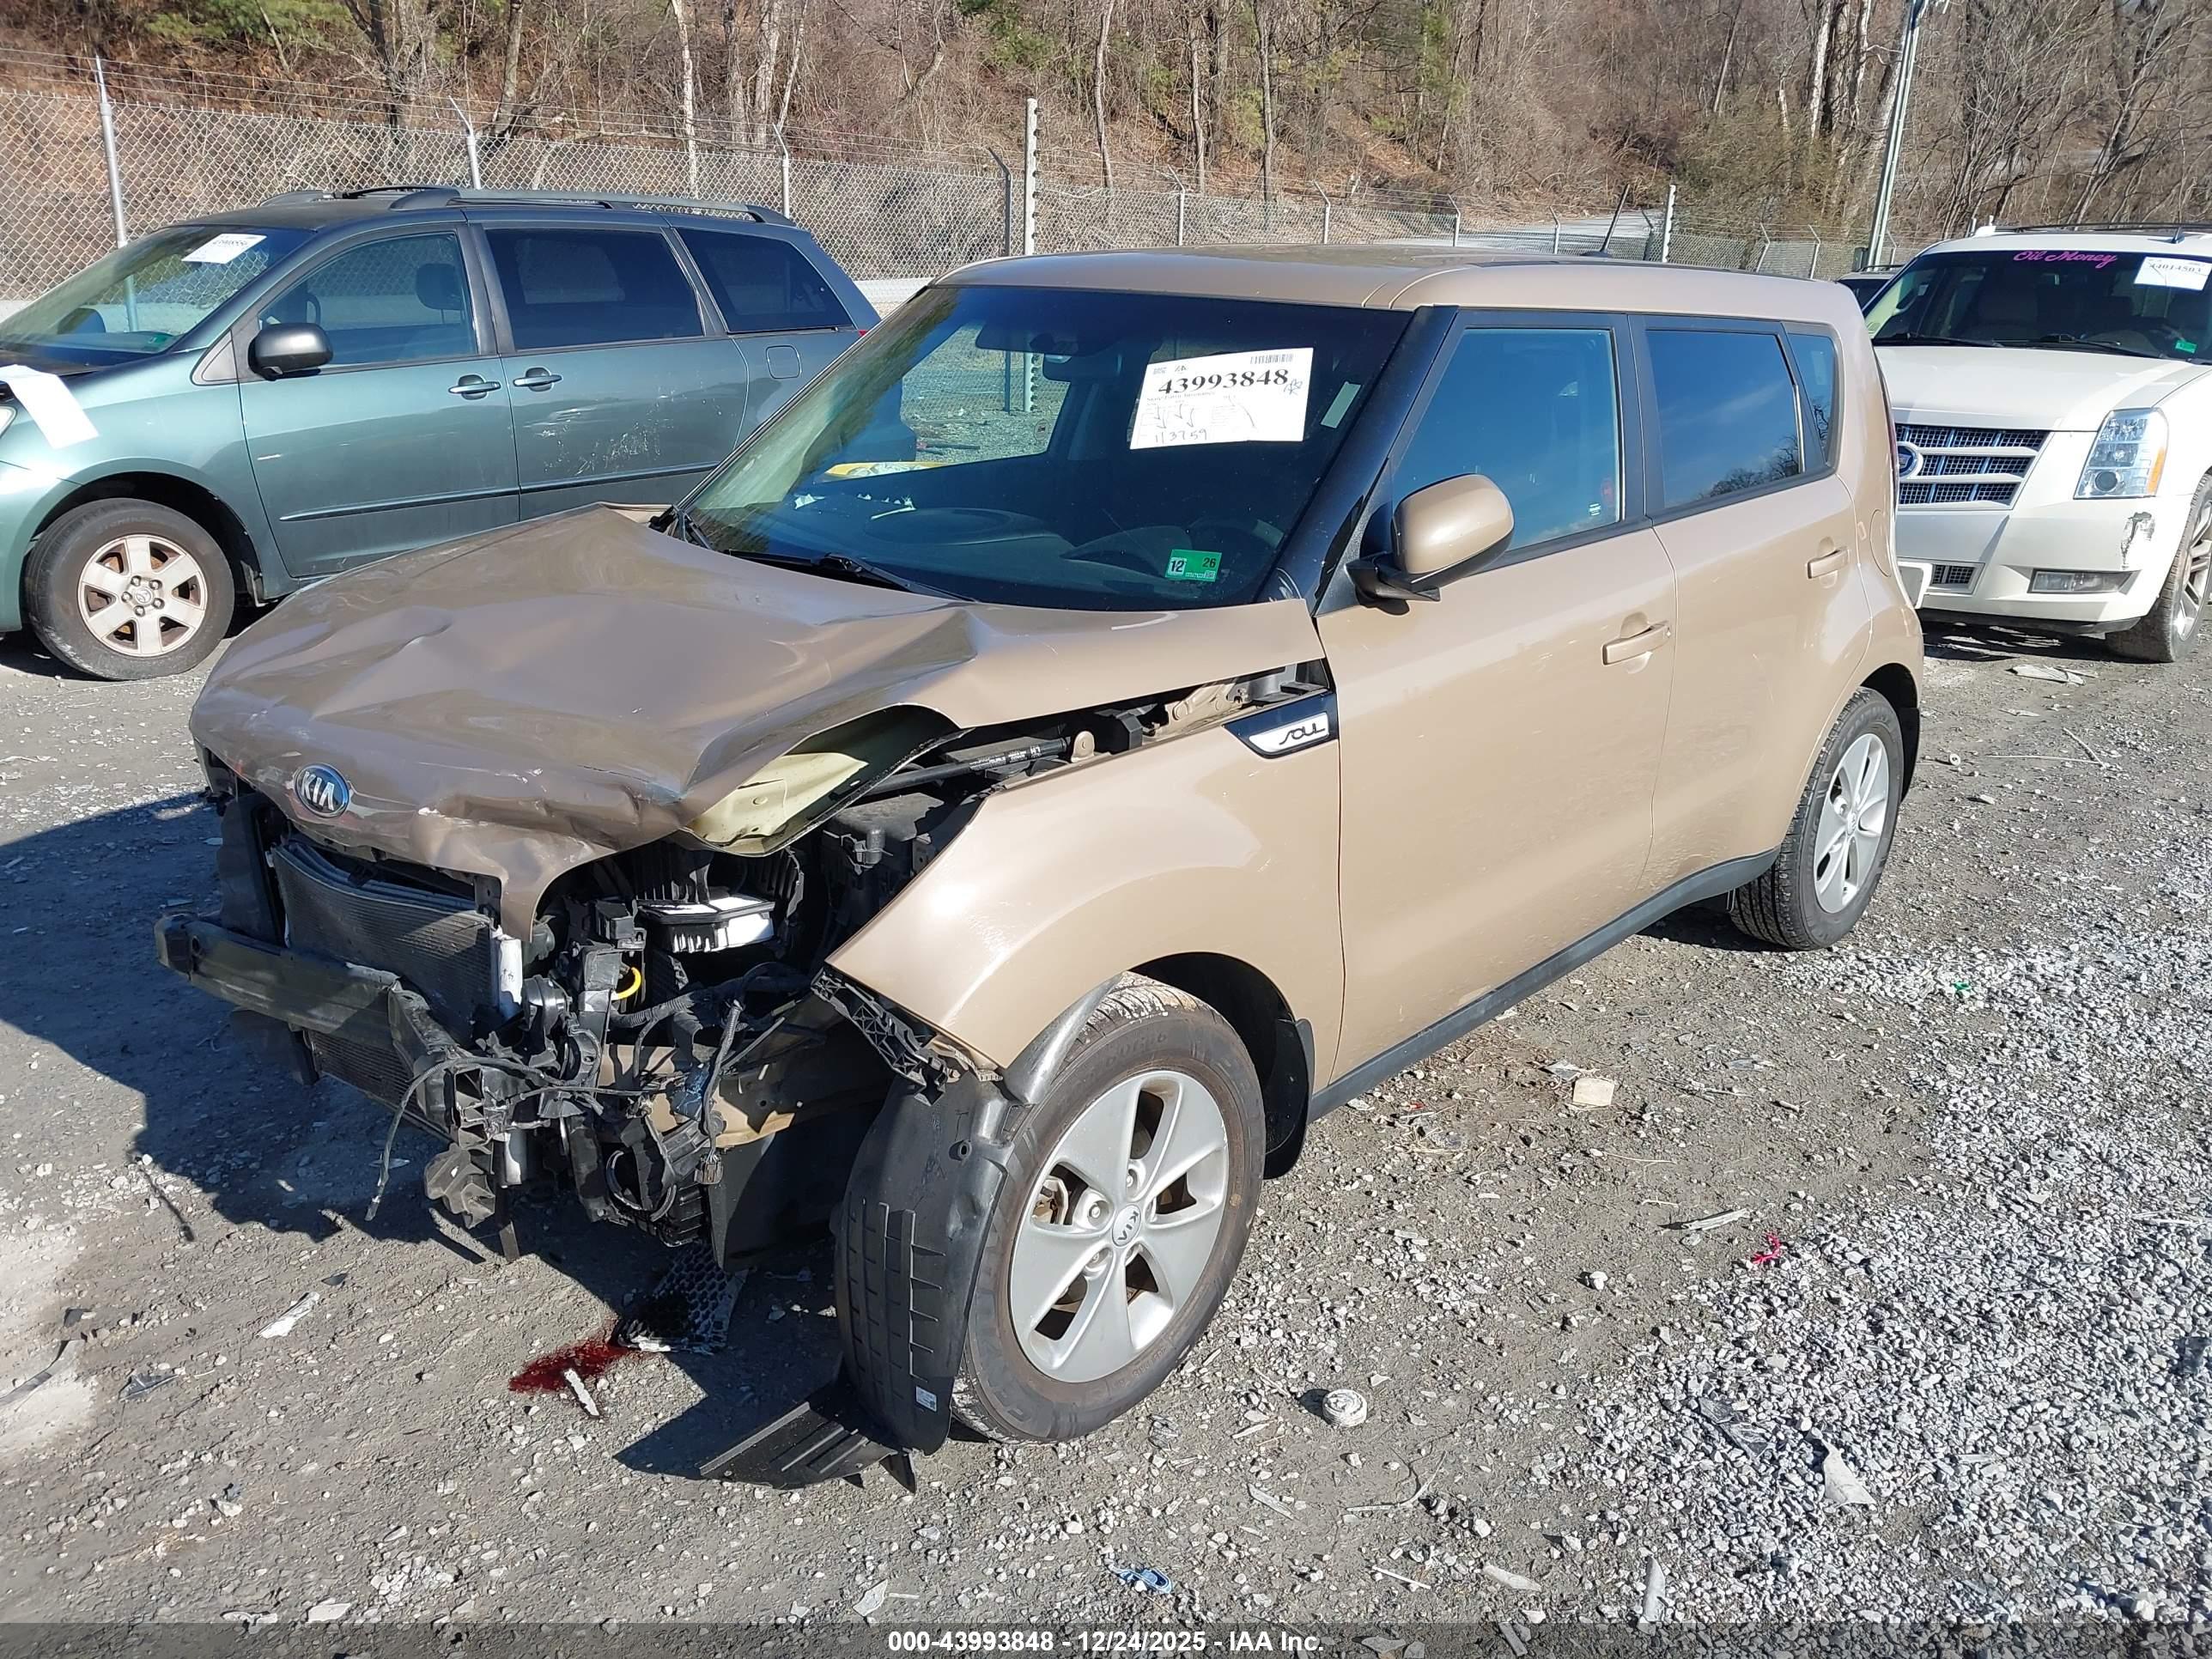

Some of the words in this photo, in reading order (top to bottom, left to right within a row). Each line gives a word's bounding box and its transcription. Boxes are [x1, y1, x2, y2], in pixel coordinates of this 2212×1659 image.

[2013, 250, 2047, 261] Oil
[2045, 251, 2118, 269] Money
[1158, 368, 1290, 394] 43993848
[1170, 560, 1185, 573] 12
[1202, 557, 1217, 568] 26
[301, 771, 335, 811] KIA
[1116, 1210, 1139, 1241] KIA
